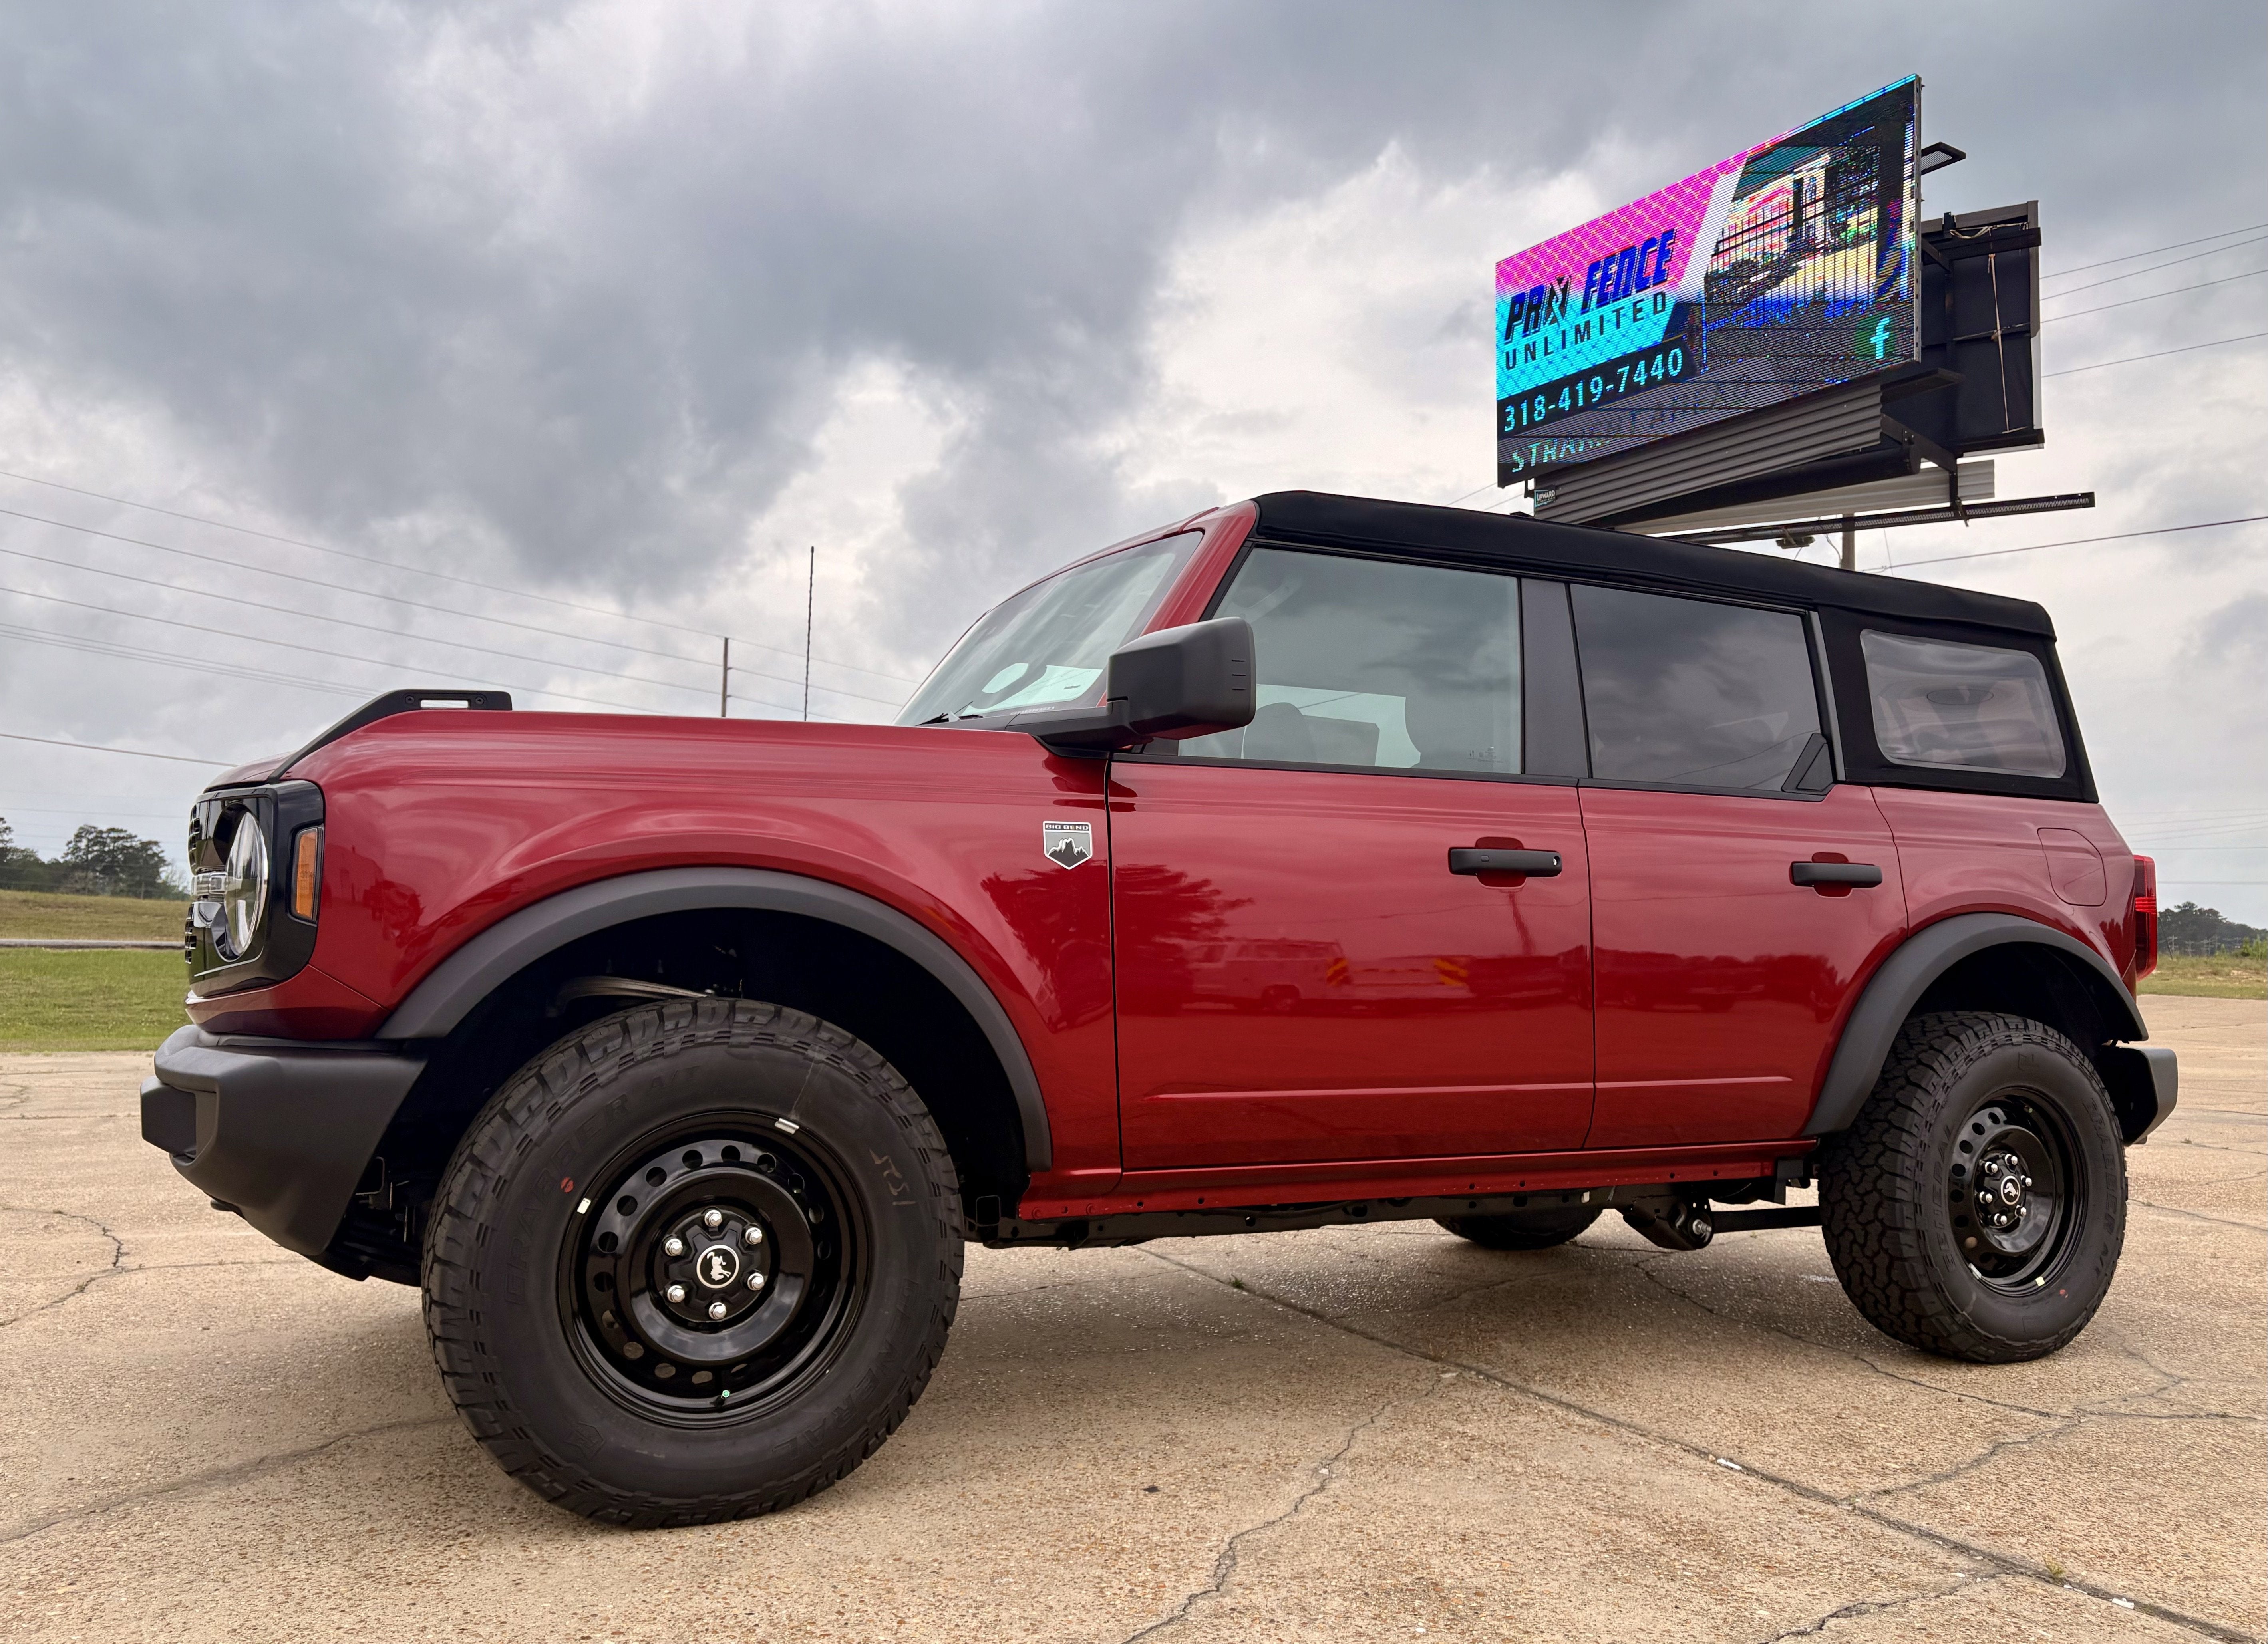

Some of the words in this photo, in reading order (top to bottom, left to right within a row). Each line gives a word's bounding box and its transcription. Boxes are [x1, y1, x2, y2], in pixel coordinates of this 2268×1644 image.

[1581, 228, 1678, 314] FENCE
[1506, 291, 1666, 369] UNLIMITED
[1504, 348, 1682, 432] 318-419-7440
[503, 1094, 630, 1305] GRABBER
[1932, 1124, 1956, 1272] GENERAL
[771, 1276, 920, 1458] GENERAL
